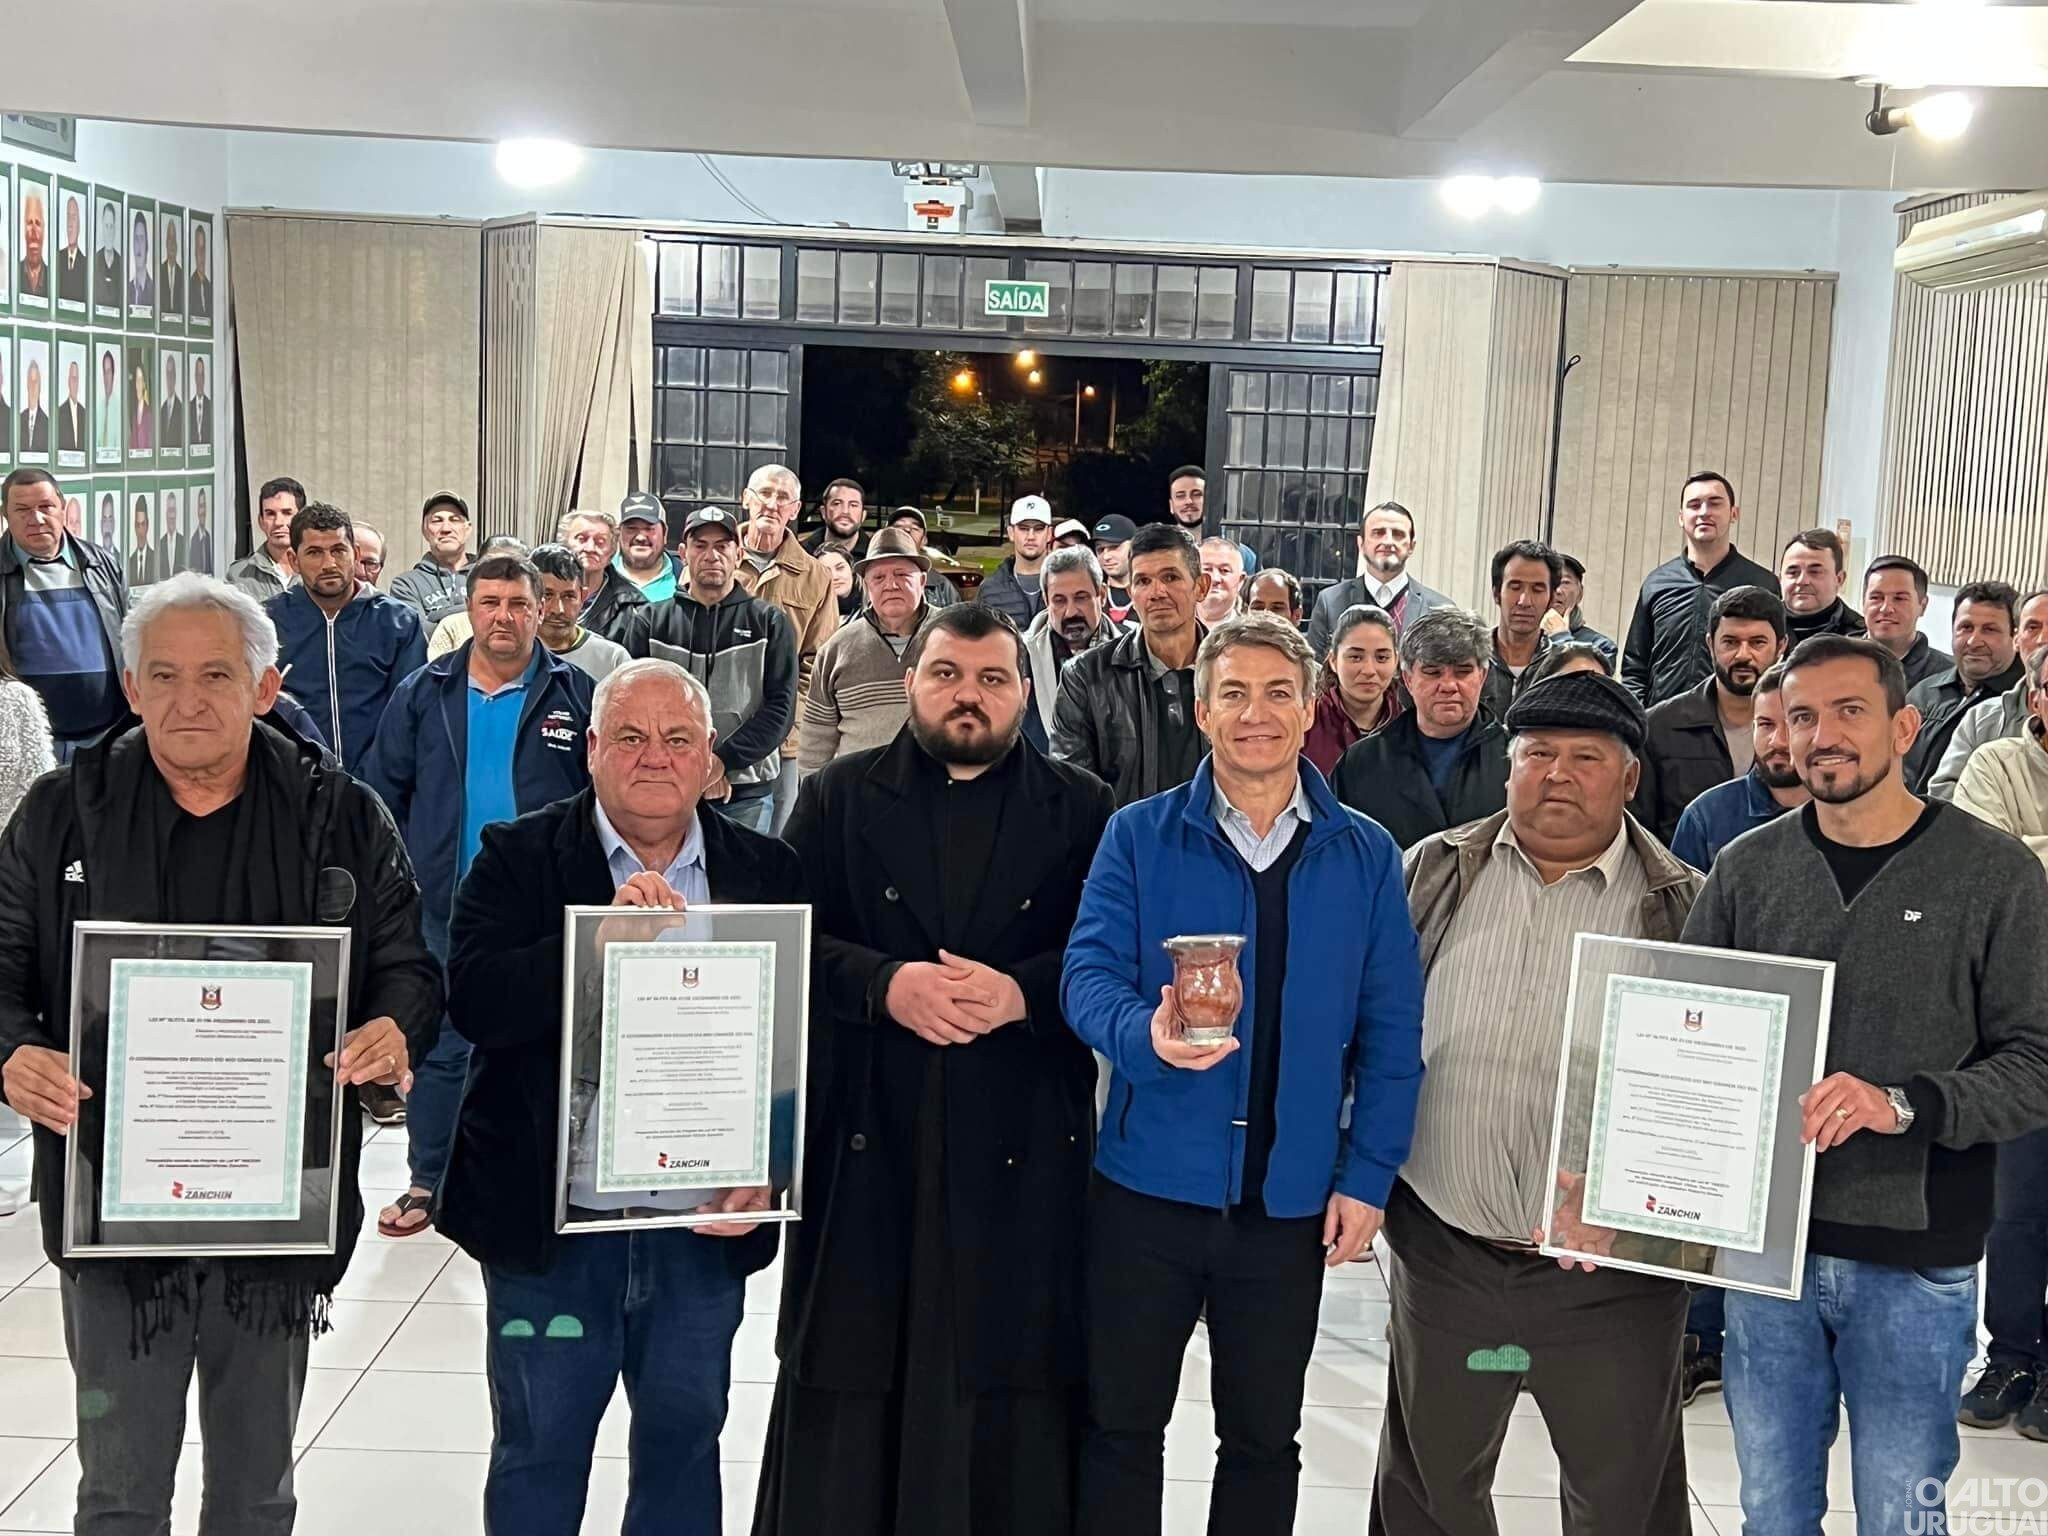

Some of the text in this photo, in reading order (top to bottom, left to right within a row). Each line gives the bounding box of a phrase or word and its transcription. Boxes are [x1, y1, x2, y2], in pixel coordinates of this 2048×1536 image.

[988, 286, 1044, 311] SAÍDA
[1904, 909, 1922, 922] DF
[669, 1159, 710, 1169] ZANCHIN
[184, 1190, 233, 1200] ZANCHIN
[1657, 1206, 1701, 1221] ZANCHIN
